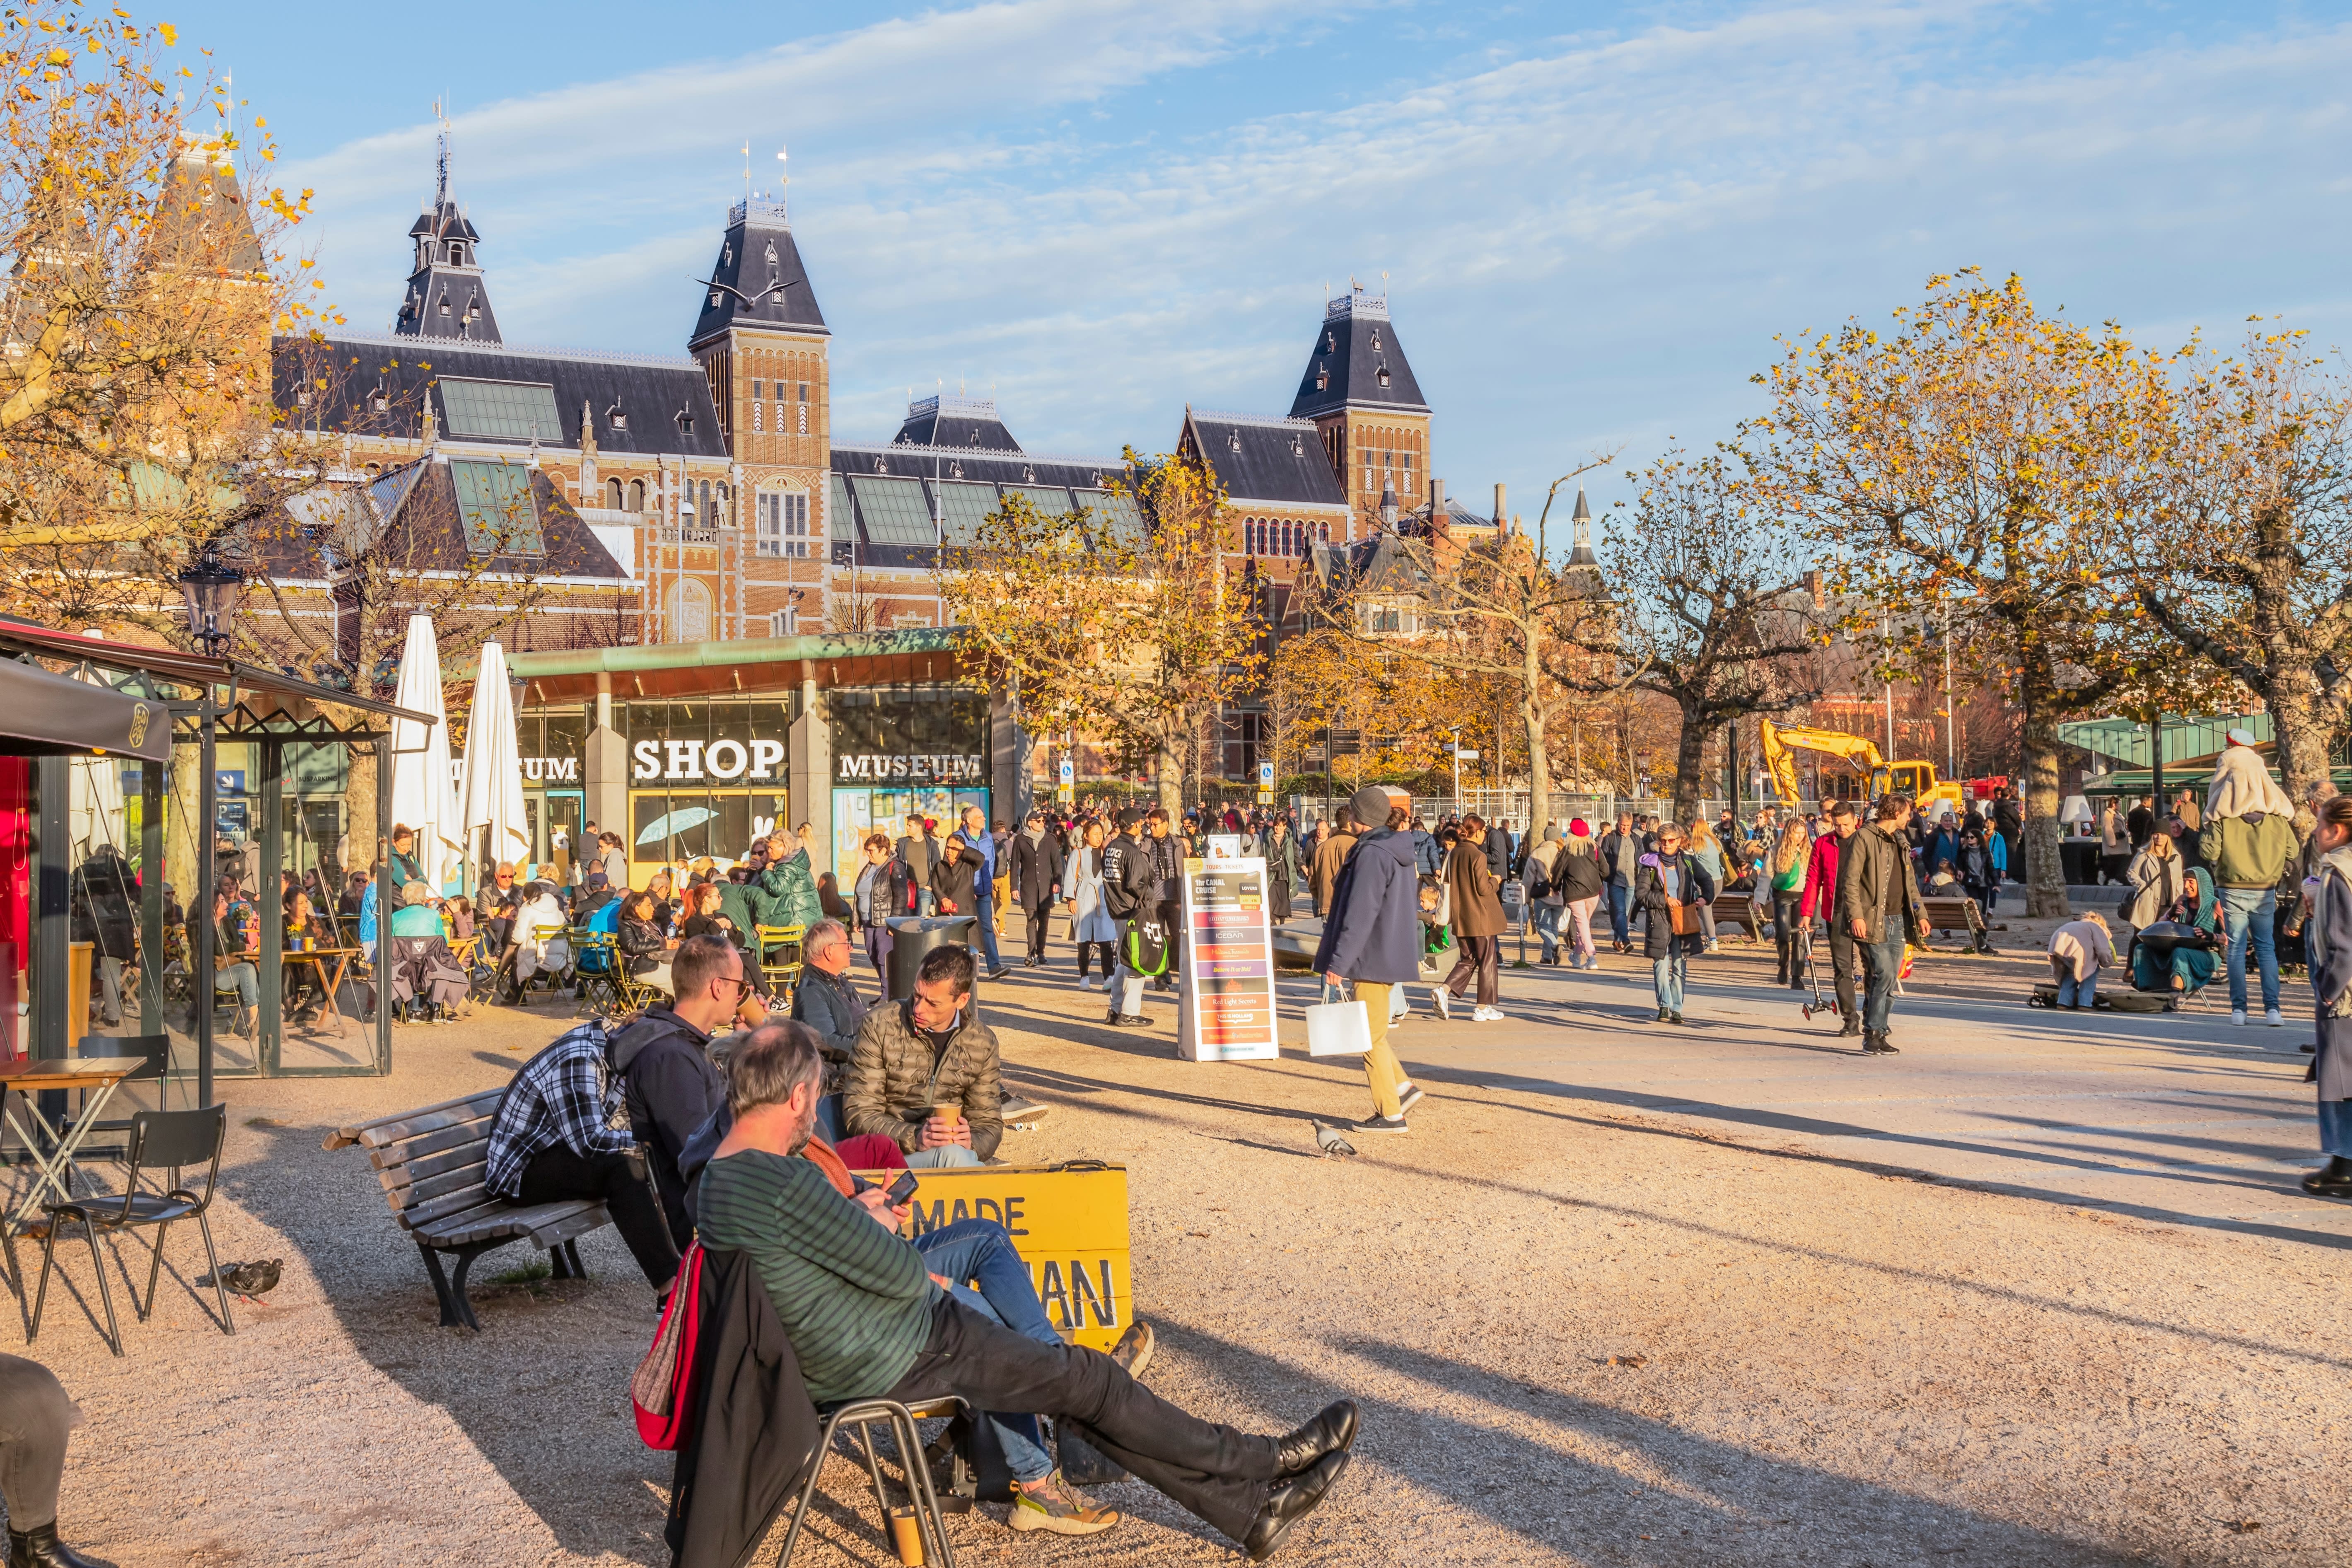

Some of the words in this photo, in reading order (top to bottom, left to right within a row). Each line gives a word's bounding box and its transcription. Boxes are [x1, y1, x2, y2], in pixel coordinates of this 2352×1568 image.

[634, 739, 785, 779] SHOP
[839, 754, 982, 777] MUSEUM
[218, 805, 227, 819] P
[913, 1197, 1029, 1239] MADE
